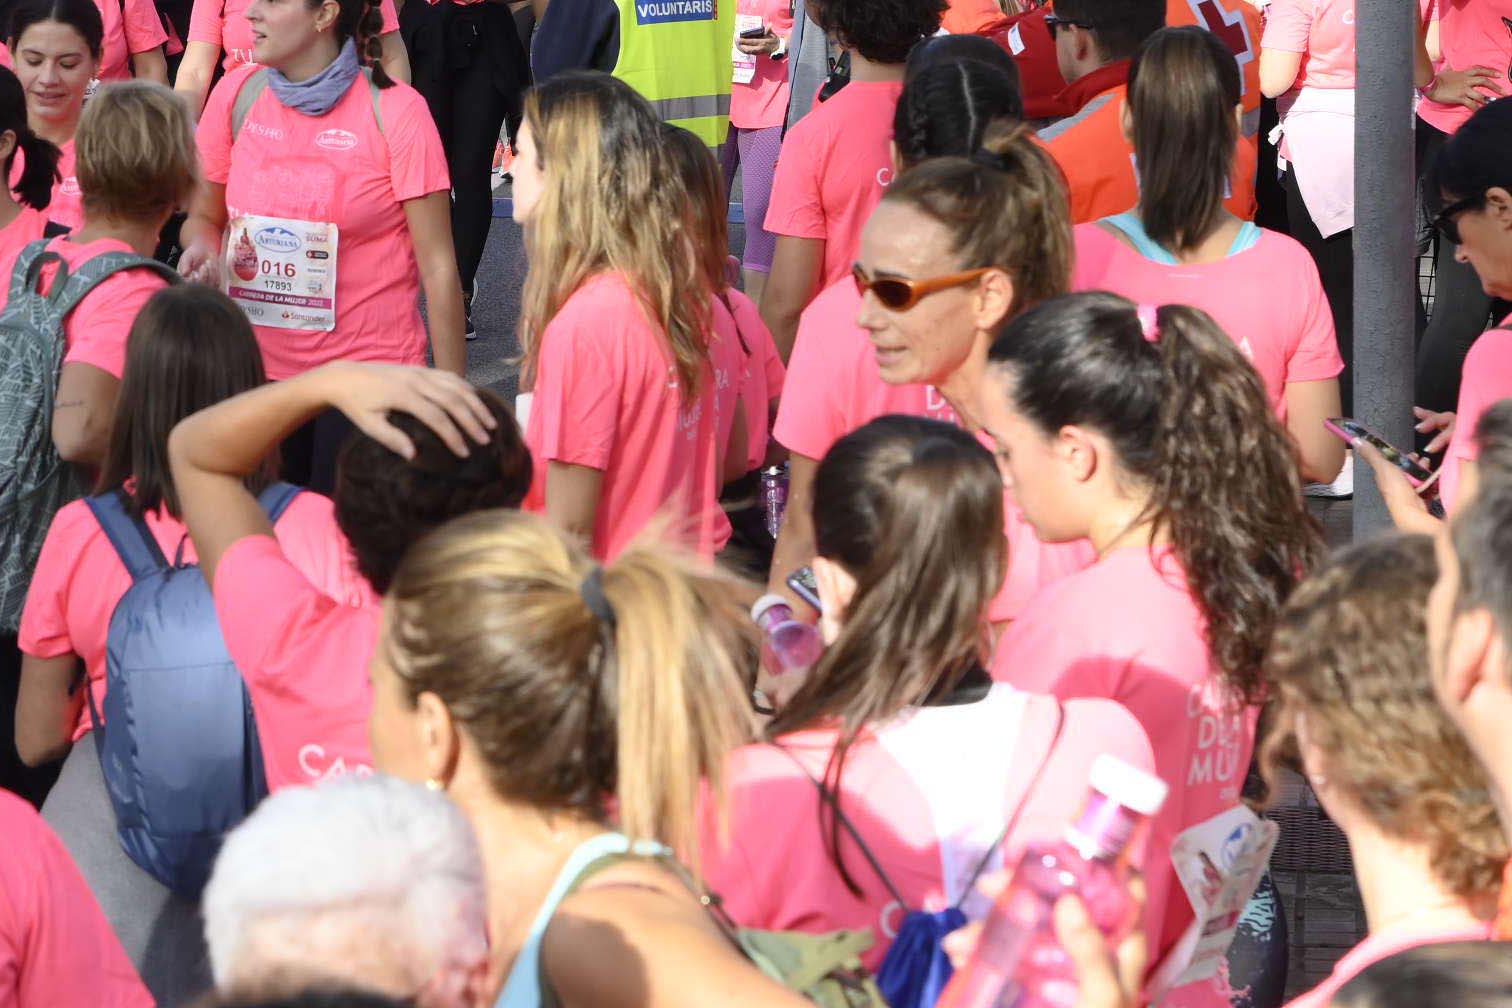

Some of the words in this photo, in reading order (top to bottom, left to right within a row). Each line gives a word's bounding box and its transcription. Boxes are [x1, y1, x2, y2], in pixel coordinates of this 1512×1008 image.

[637, 0, 713, 23] VOLUNTARIS
[261, 259, 296, 278] 016
[264, 280, 292, 292] 17893
